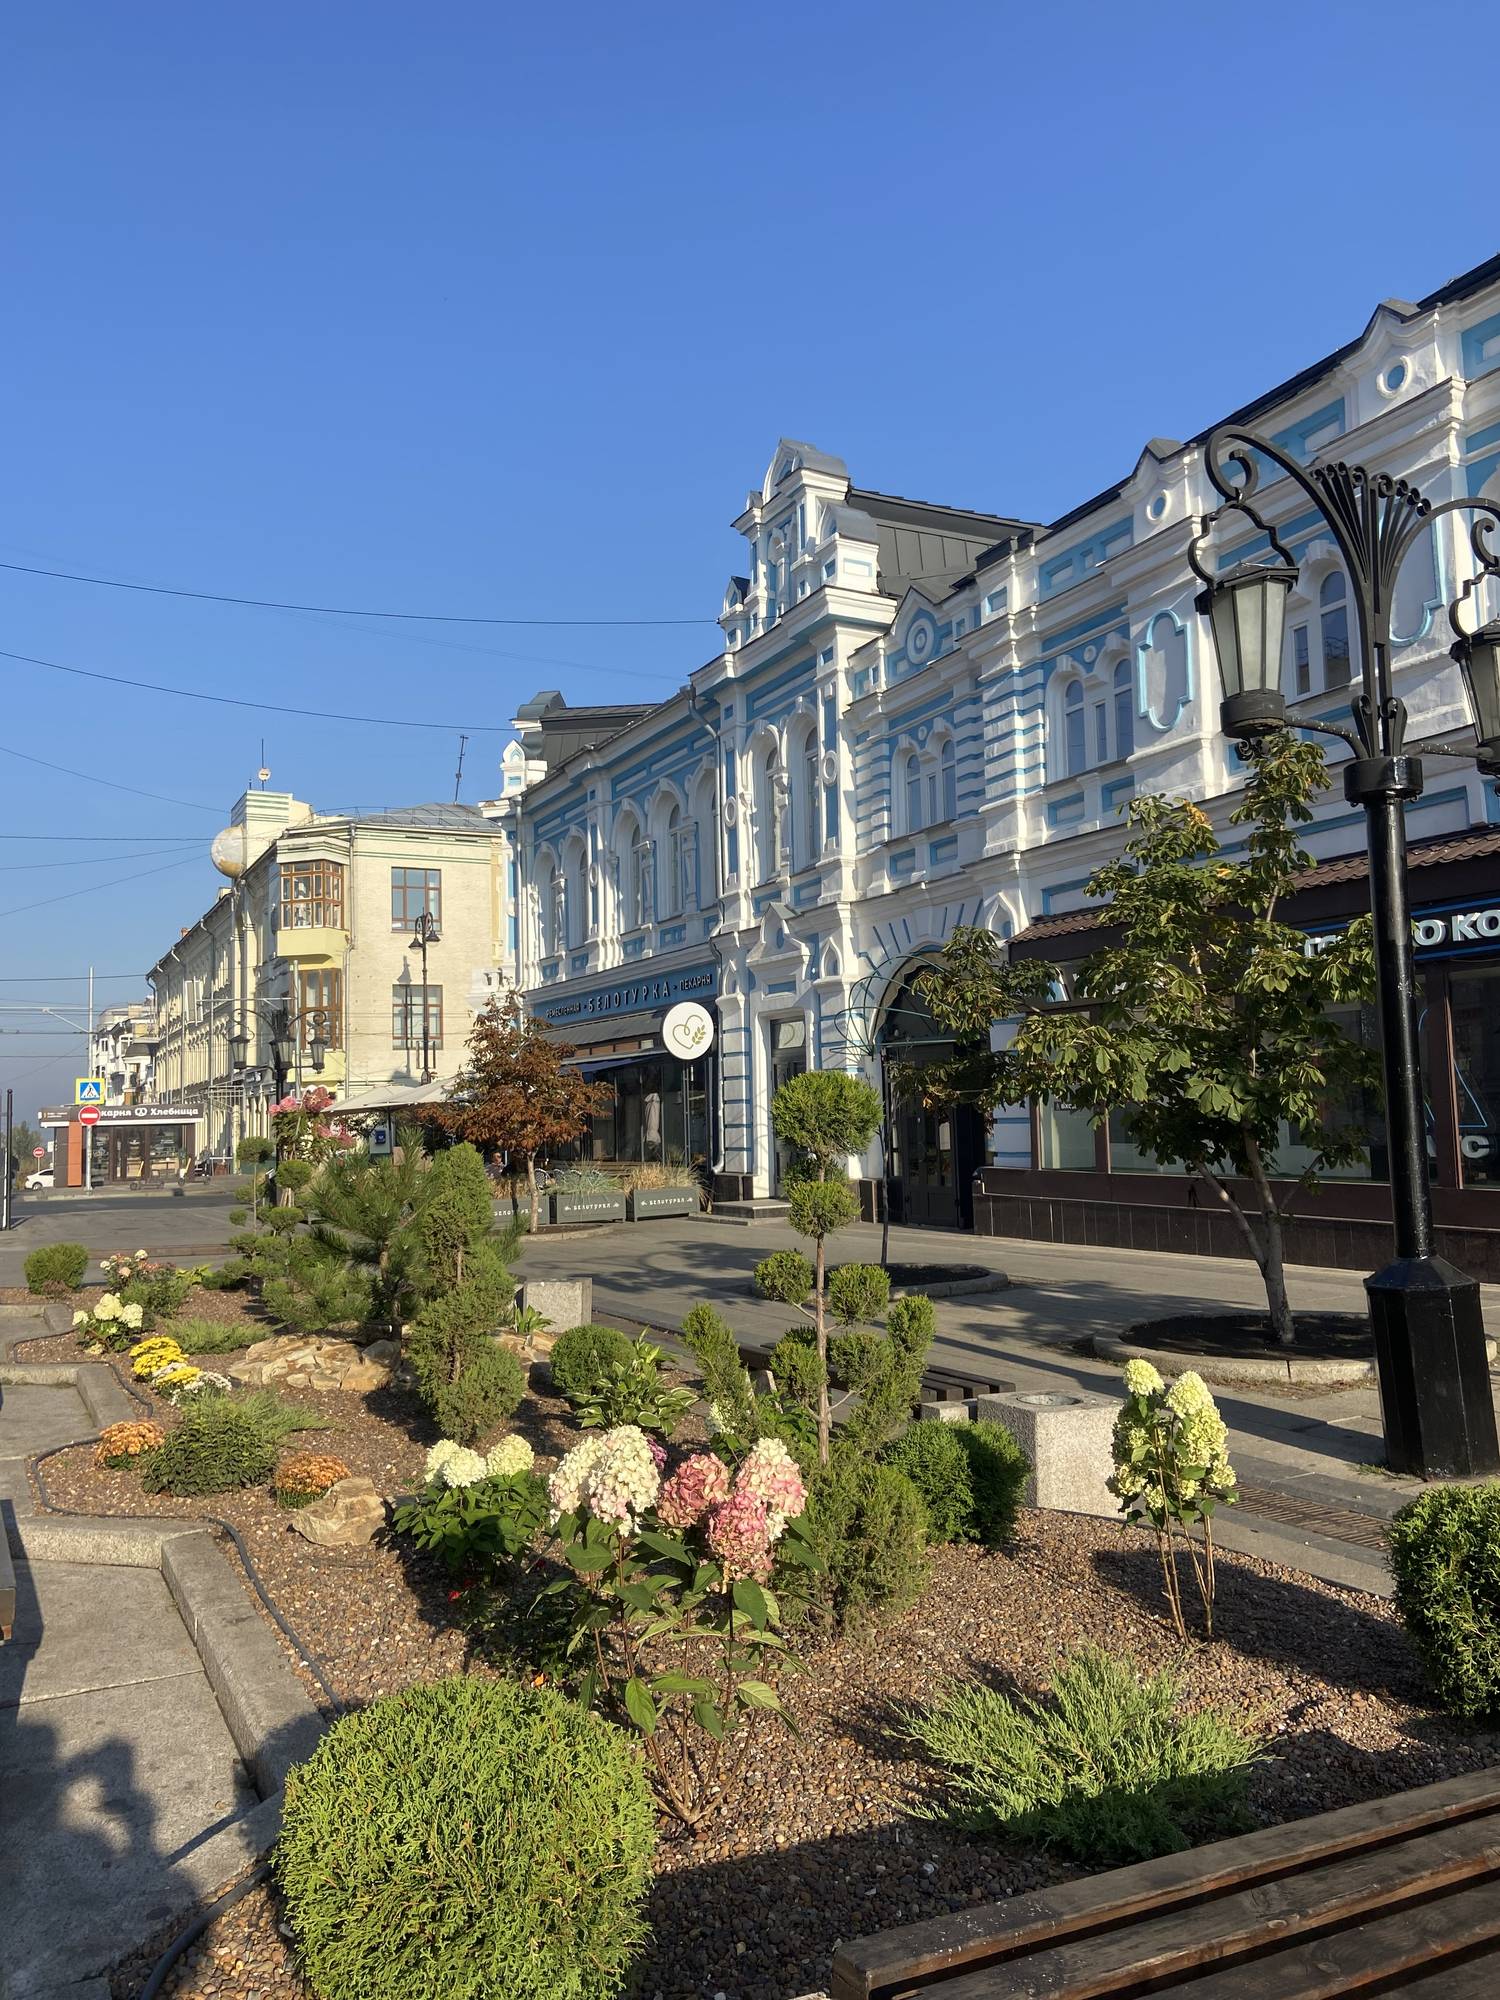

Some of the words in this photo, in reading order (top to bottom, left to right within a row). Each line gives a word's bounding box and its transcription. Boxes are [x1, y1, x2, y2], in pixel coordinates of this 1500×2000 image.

[587, 981, 671, 1013] БЕЛОТУРКА
[679, 973, 712, 991] ПЕКАРНЯ
[101, 1110, 132, 1118] карня
[150, 1107, 199, 1116] Хлебница
[650, 1198, 684, 1206] БЕЛОТУРКА
